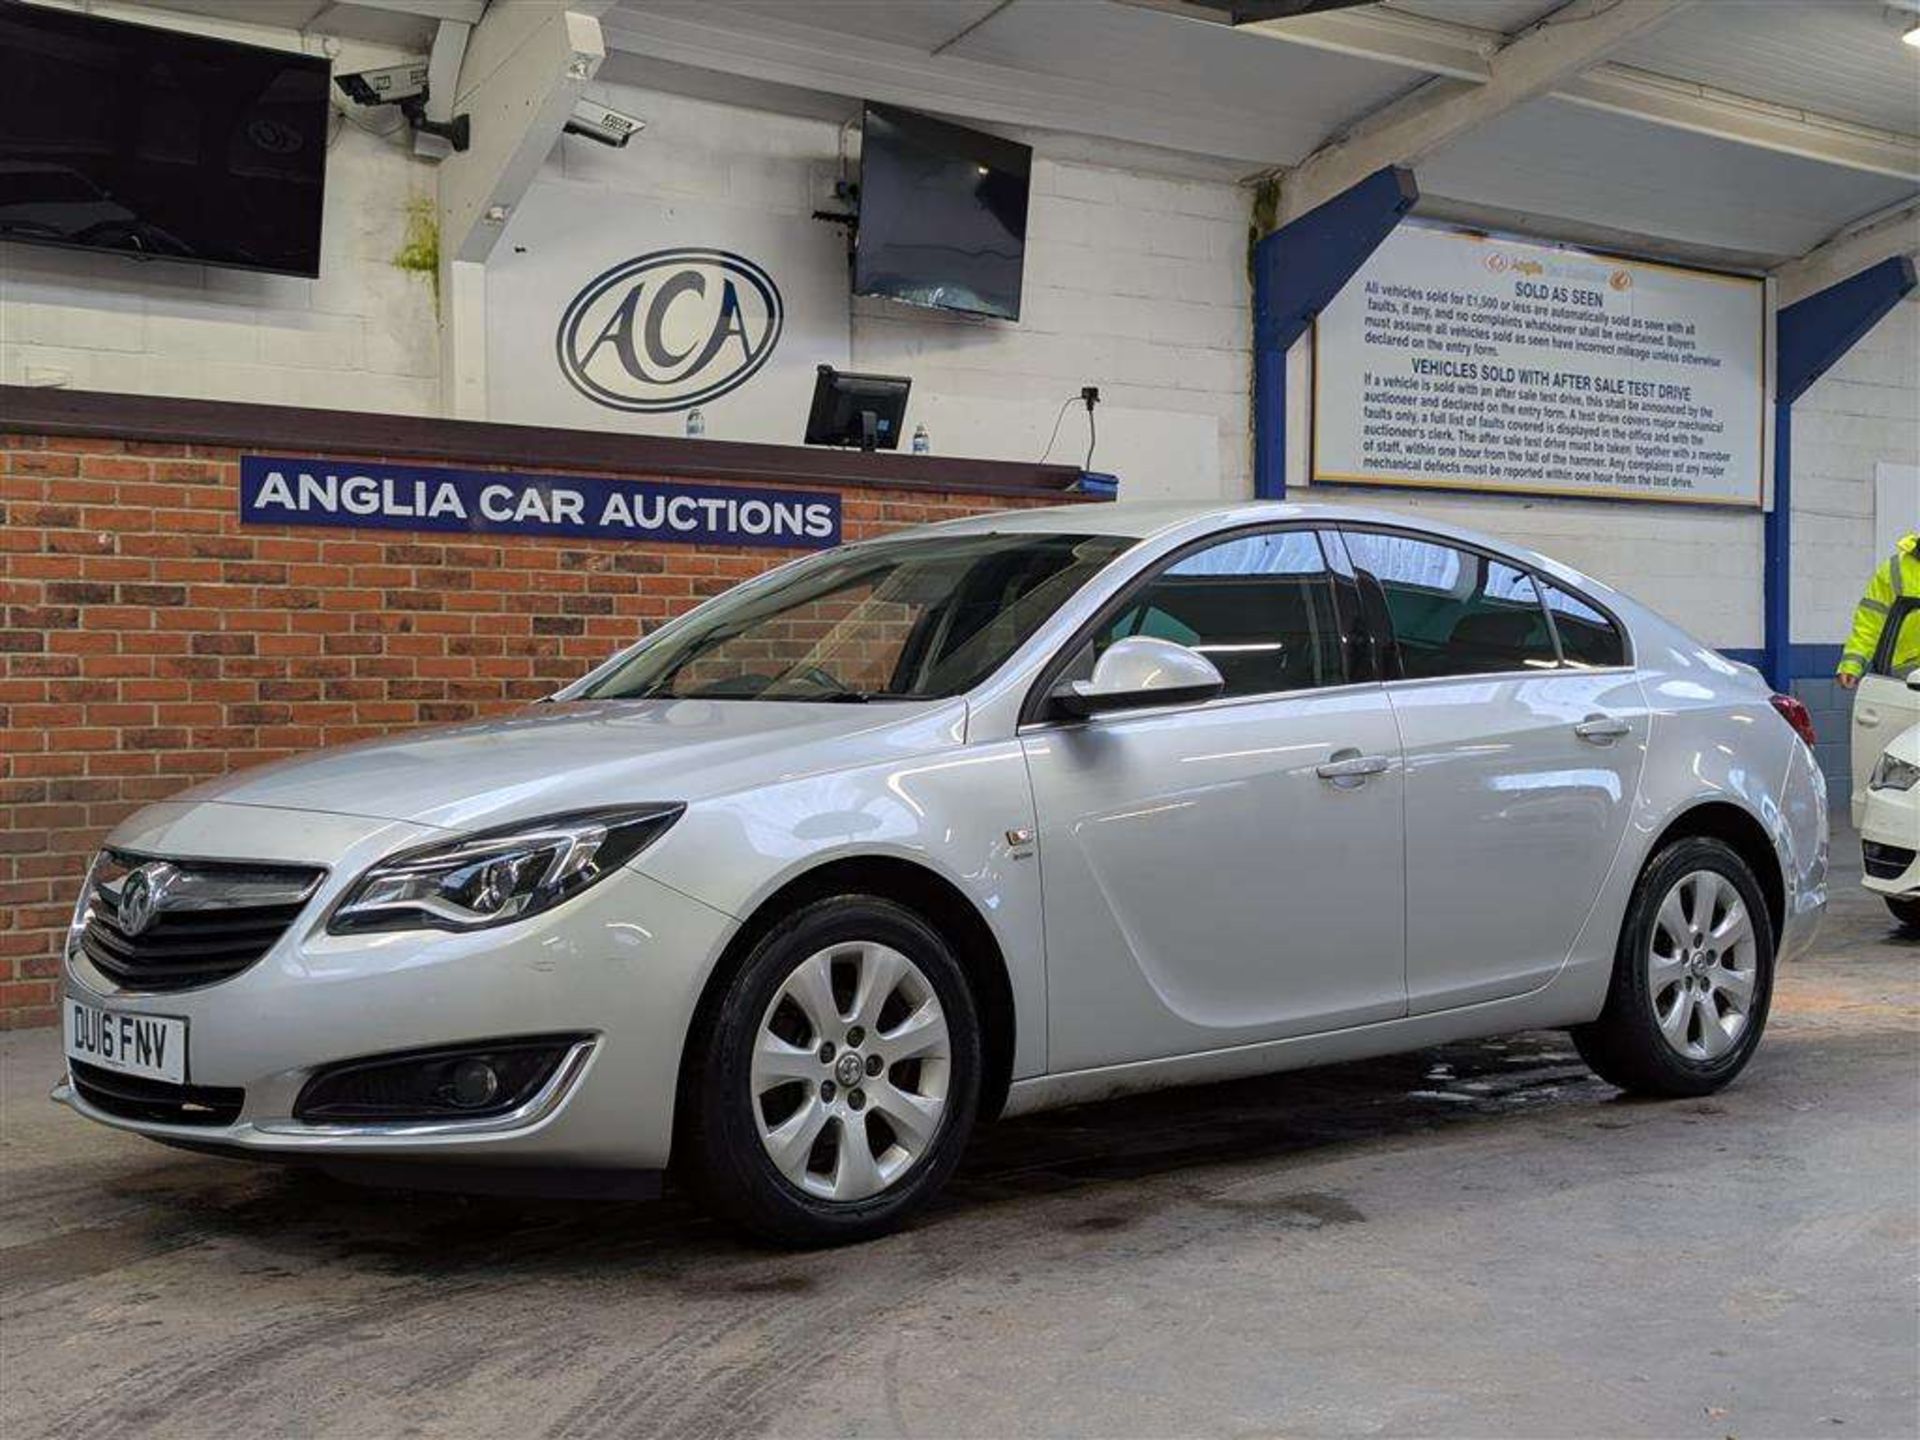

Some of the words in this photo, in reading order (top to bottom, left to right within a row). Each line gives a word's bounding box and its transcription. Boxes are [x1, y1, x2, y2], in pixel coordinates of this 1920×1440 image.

[1365, 281, 1378, 293] All
[1382, 285, 1423, 299] vehicles
[1426, 290, 1448, 304] sold
[1450, 292, 1464, 305] for
[1513, 302, 1530, 313] less
[1534, 304, 1548, 315] are
[1551, 308, 1609, 326] automatically
[1611, 315, 1629, 326] sold
[1644, 320, 1665, 330] seen
[1667, 321, 1683, 333] with
[1516, 281, 1548, 299] SOLD
[1552, 287, 1568, 303] AS
[1572, 290, 1603, 307] SEEN
[577, 270, 754, 385] ACA
[1364, 316, 1390, 328] must
[1393, 318, 1432, 332] assume
[1436, 324, 1447, 335] all
[1450, 325, 1490, 340] vehicles
[1492, 331, 1512, 342] sold
[1528, 335, 1549, 346] seen
[1552, 337, 1574, 349] have
[1576, 340, 1615, 355] incorrect
[1618, 345, 1650, 361] mileage
[1652, 350, 1679, 363] unless
[1681, 353, 1721, 368] otherwise
[1365, 331, 1409, 347] declared
[1411, 338, 1424, 348] on
[1427, 338, 1442, 350] the
[1446, 341, 1470, 356] entry
[1435, 306, 1453, 319] and
[1456, 311, 1468, 322] no
[1471, 311, 1522, 328] complaints
[1525, 318, 1576, 335] whatsoever
[1579, 323, 1599, 337] shall
[1667, 335, 1695, 350] Buyers
[1383, 376, 1419, 390] vehicle
[1434, 381, 1454, 393] sold
[1458, 382, 1478, 395] with
[1481, 387, 1492, 396] an
[1495, 386, 1516, 399] after
[1518, 388, 1537, 400] sale
[1539, 391, 1557, 403] test
[1586, 395, 1603, 407] this
[1605, 397, 1626, 409] shall
[1628, 399, 1639, 410] be
[1641, 402, 1686, 415] announced
[1700, 406, 1712, 418] the
[1412, 358, 1477, 379] VEHICLES
[1480, 365, 1515, 382] SOLD
[1518, 368, 1549, 386] WITH
[1552, 373, 1590, 390] AFTER
[1594, 377, 1624, 394] SALE
[1628, 381, 1655, 398] TEST
[1659, 384, 1691, 401] DRIVE
[1364, 392, 1418, 406] auctioneer
[1420, 396, 1439, 407] and
[1441, 398, 1484, 411] declared
[1487, 403, 1498, 411] on
[1501, 402, 1515, 414] the
[1518, 405, 1541, 420] entry
[1578, 410, 1596, 421] test
[1598, 411, 1619, 424] drive
[1622, 416, 1651, 426] covers
[1653, 418, 1676, 430] major
[1678, 420, 1723, 433] mechanical
[1364, 406, 1392, 419] faults
[1430, 413, 1446, 424] full
[1449, 413, 1464, 424] list
[1479, 417, 1505, 429] faults
[1507, 419, 1543, 432] covered
[1556, 424, 1600, 438] displayed
[1612, 429, 1626, 440] the
[1629, 431, 1652, 442] office
[1655, 432, 1669, 443] and
[1672, 434, 1688, 444] with
[1691, 435, 1703, 445] the
[1363, 440, 1374, 451] of
[1405, 443, 1436, 455] within
[1438, 447, 1456, 456] one
[1458, 445, 1481, 458] hour
[1484, 448, 1505, 460] from
[1508, 450, 1522, 461] the
[1525, 451, 1539, 462] fall
[1552, 453, 1567, 465] the
[1609, 458, 1625, 471] Any
[1628, 459, 1673, 472] complaints
[1686, 465, 1700, 475] any
[1702, 465, 1725, 478] major
[1458, 430, 1476, 442] The
[1479, 431, 1500, 444] after
[1503, 435, 1522, 445] sale
[1524, 435, 1541, 448] test
[1543, 439, 1566, 449] drive
[1569, 441, 1591, 450] must
[1635, 445, 1669, 458] together
[1672, 447, 1689, 458] with
[1699, 450, 1731, 462] member
[1363, 456, 1422, 470] mechanical
[1423, 460, 1461, 473] defects
[1463, 463, 1488, 474] must
[1489, 465, 1500, 476] be
[1503, 467, 1543, 479] reported
[1546, 468, 1572, 479] within
[1575, 471, 1591, 481] one
[1594, 470, 1613, 482] hour
[1615, 472, 1635, 483] from
[1638, 474, 1651, 484] the
[1653, 476, 1669, 486] test
[254, 471, 467, 519] ANGLIA
[479, 484, 584, 525] CAR
[599, 493, 834, 537] AUCTIONS
[74, 1005, 113, 1058] DU16
[120, 1015, 167, 1069] FNV
